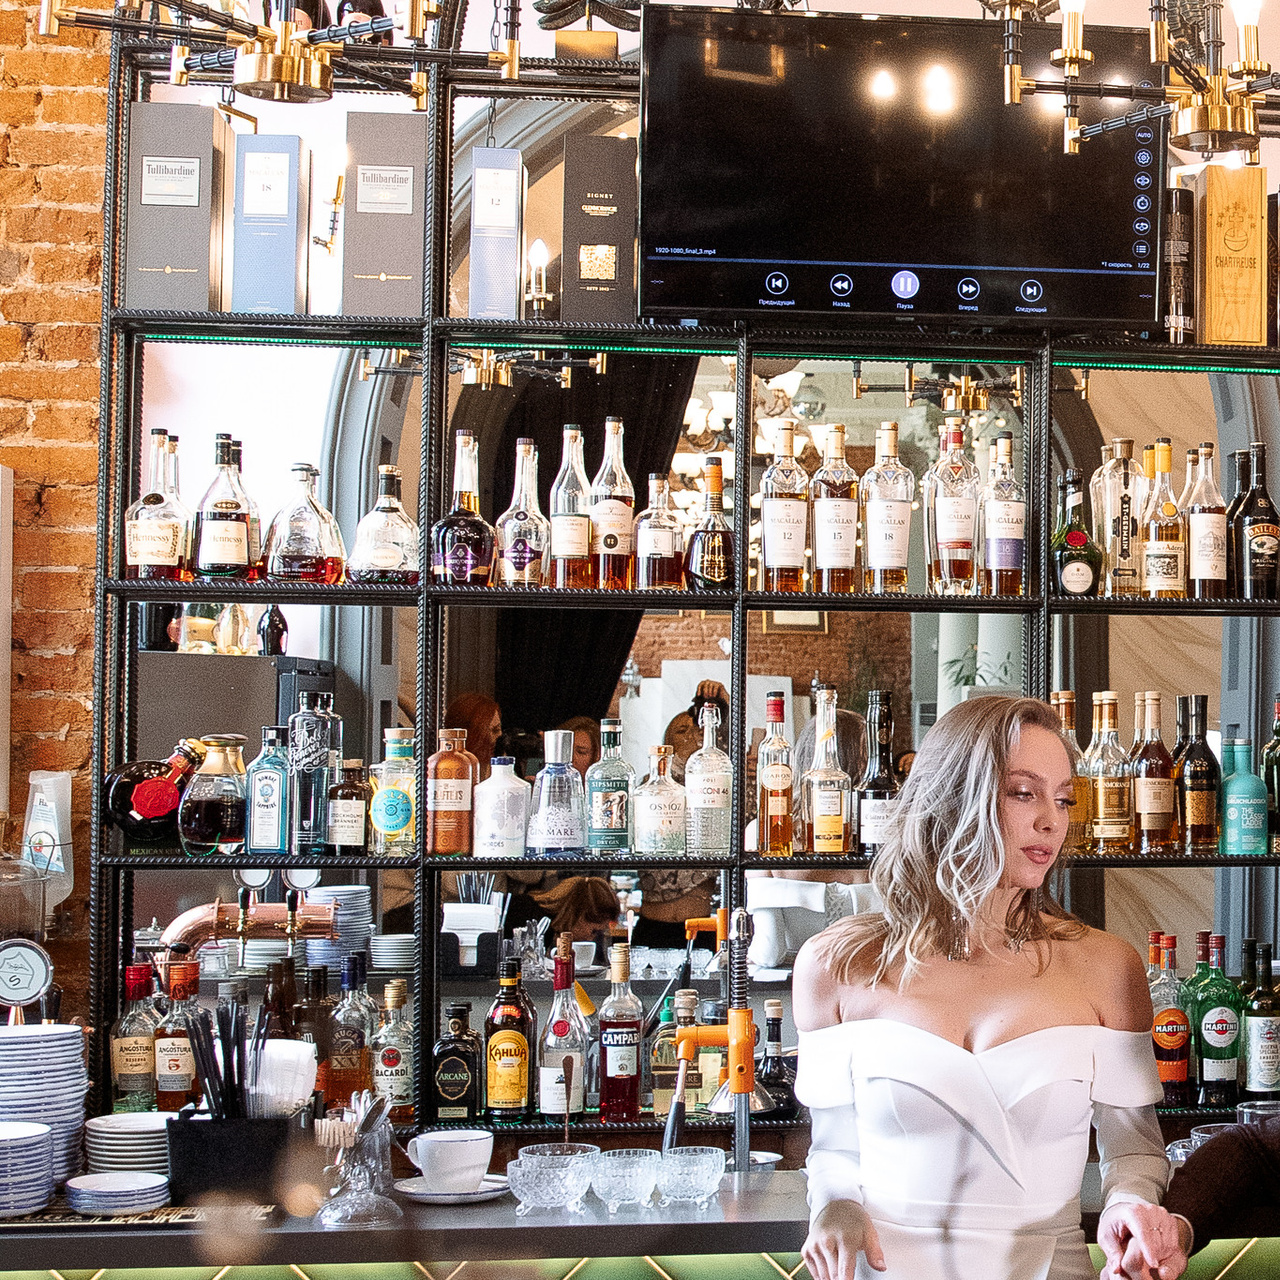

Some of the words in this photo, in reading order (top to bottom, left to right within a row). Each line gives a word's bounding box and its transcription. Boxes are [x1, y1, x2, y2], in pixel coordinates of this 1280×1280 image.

[146, 164, 195, 176] Tullibardine
[360, 172, 409, 184] Tullibardine
[586, 192, 614, 200] SIGNET
[1215, 255, 1257, 269] CHARTREUSE
[758, 299, 796, 307] Предыдущий
[832, 300, 851, 308] Назад
[896, 302, 914, 310] Пауза
[958, 304, 979, 312] Вперед
[1015, 305, 1048, 314] Следующий
[783, 532, 793, 540] 12
[833, 532, 843, 540] 15
[884, 532, 894, 540] 18
[1248, 525, 1280, 538] BAILEYS
[132, 533, 171, 543] Hennessy
[257, 774, 277, 783] BOMBAY
[650, 802, 682, 811] OSMOZ
[546, 828, 575, 836] MARE
[1155, 1024, 1187, 1033] MARTINI
[1205, 1023, 1237, 1031] MARTINI
[119, 1045, 152, 1053] ANGOSTURA
[158, 1046, 192, 1054] ANGOSTURA
[489, 1044, 527, 1062] KAHLÚA
[168, 1058, 181, 1071] 5
[333, 1056, 361, 1068] XV
[375, 1066, 409, 1077] BACARDÍ
[438, 1072, 469, 1081] ARCANE
